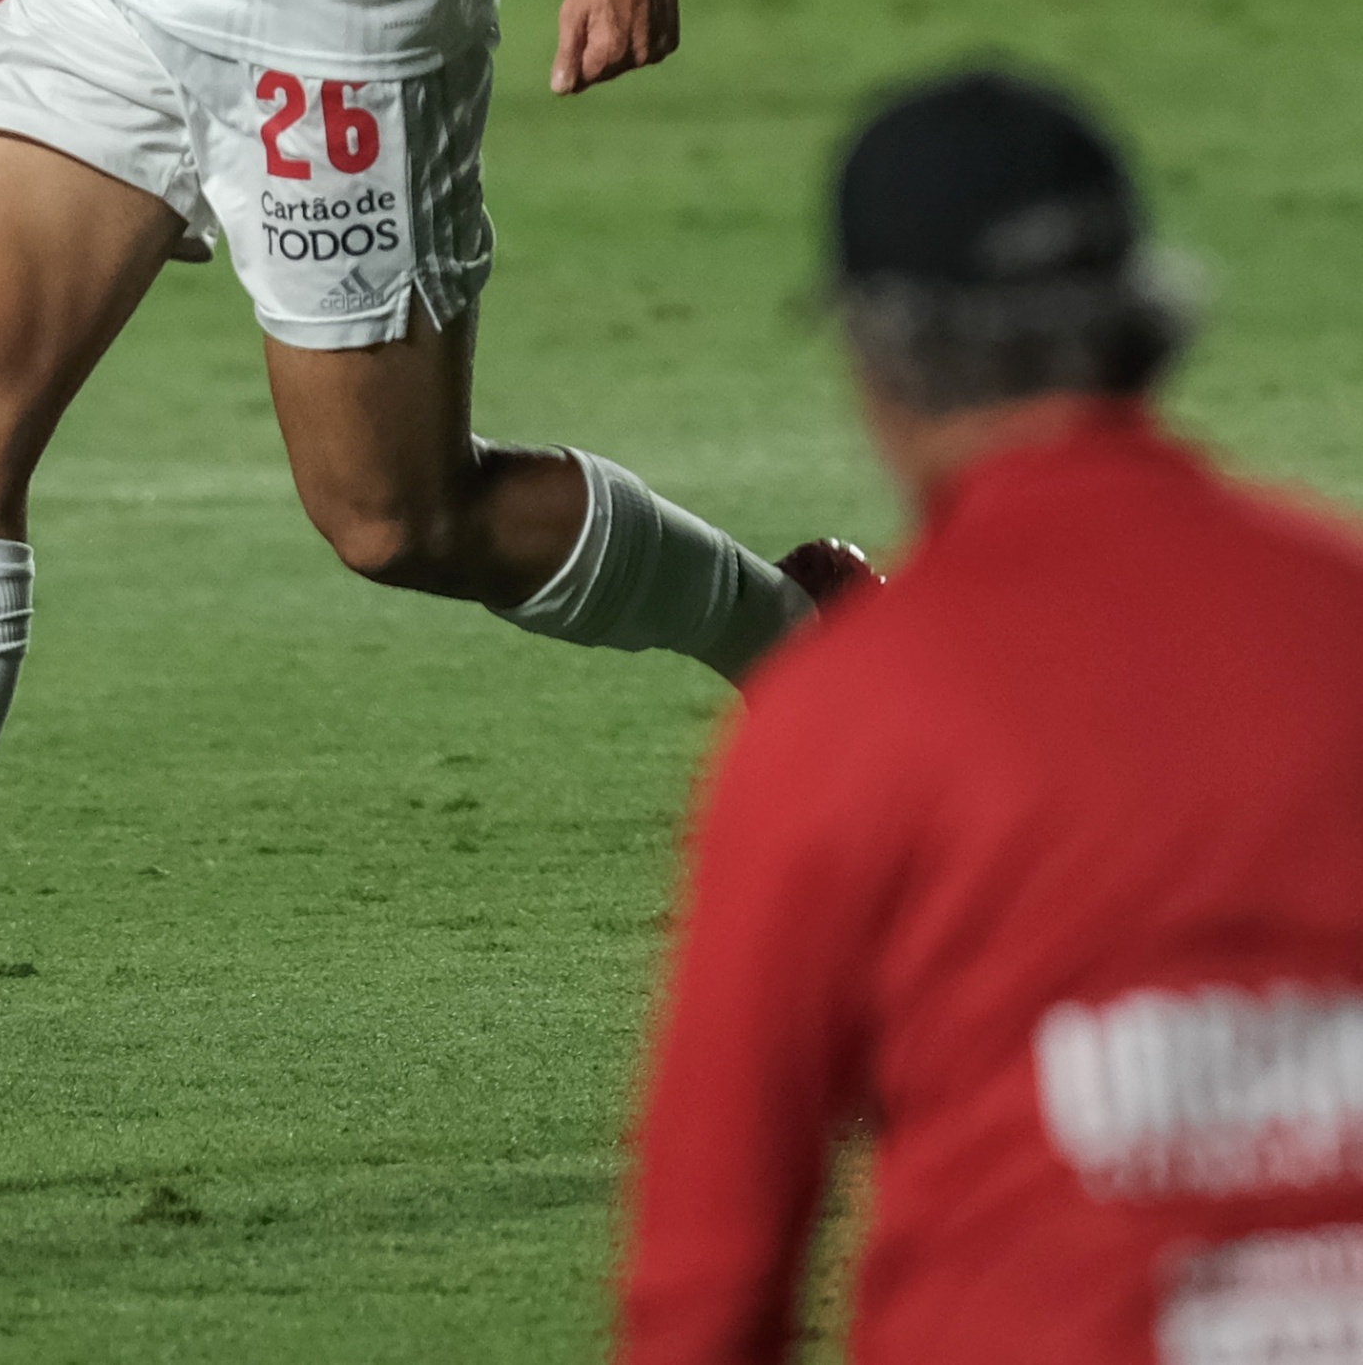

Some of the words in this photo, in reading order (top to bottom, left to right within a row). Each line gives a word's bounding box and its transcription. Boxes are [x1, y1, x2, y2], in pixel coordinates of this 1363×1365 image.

[256, 69, 380, 181] 26
[261, 190, 351, 222] Cartão
[356, 188, 396, 215] de
[262, 218, 400, 262] TODOS
